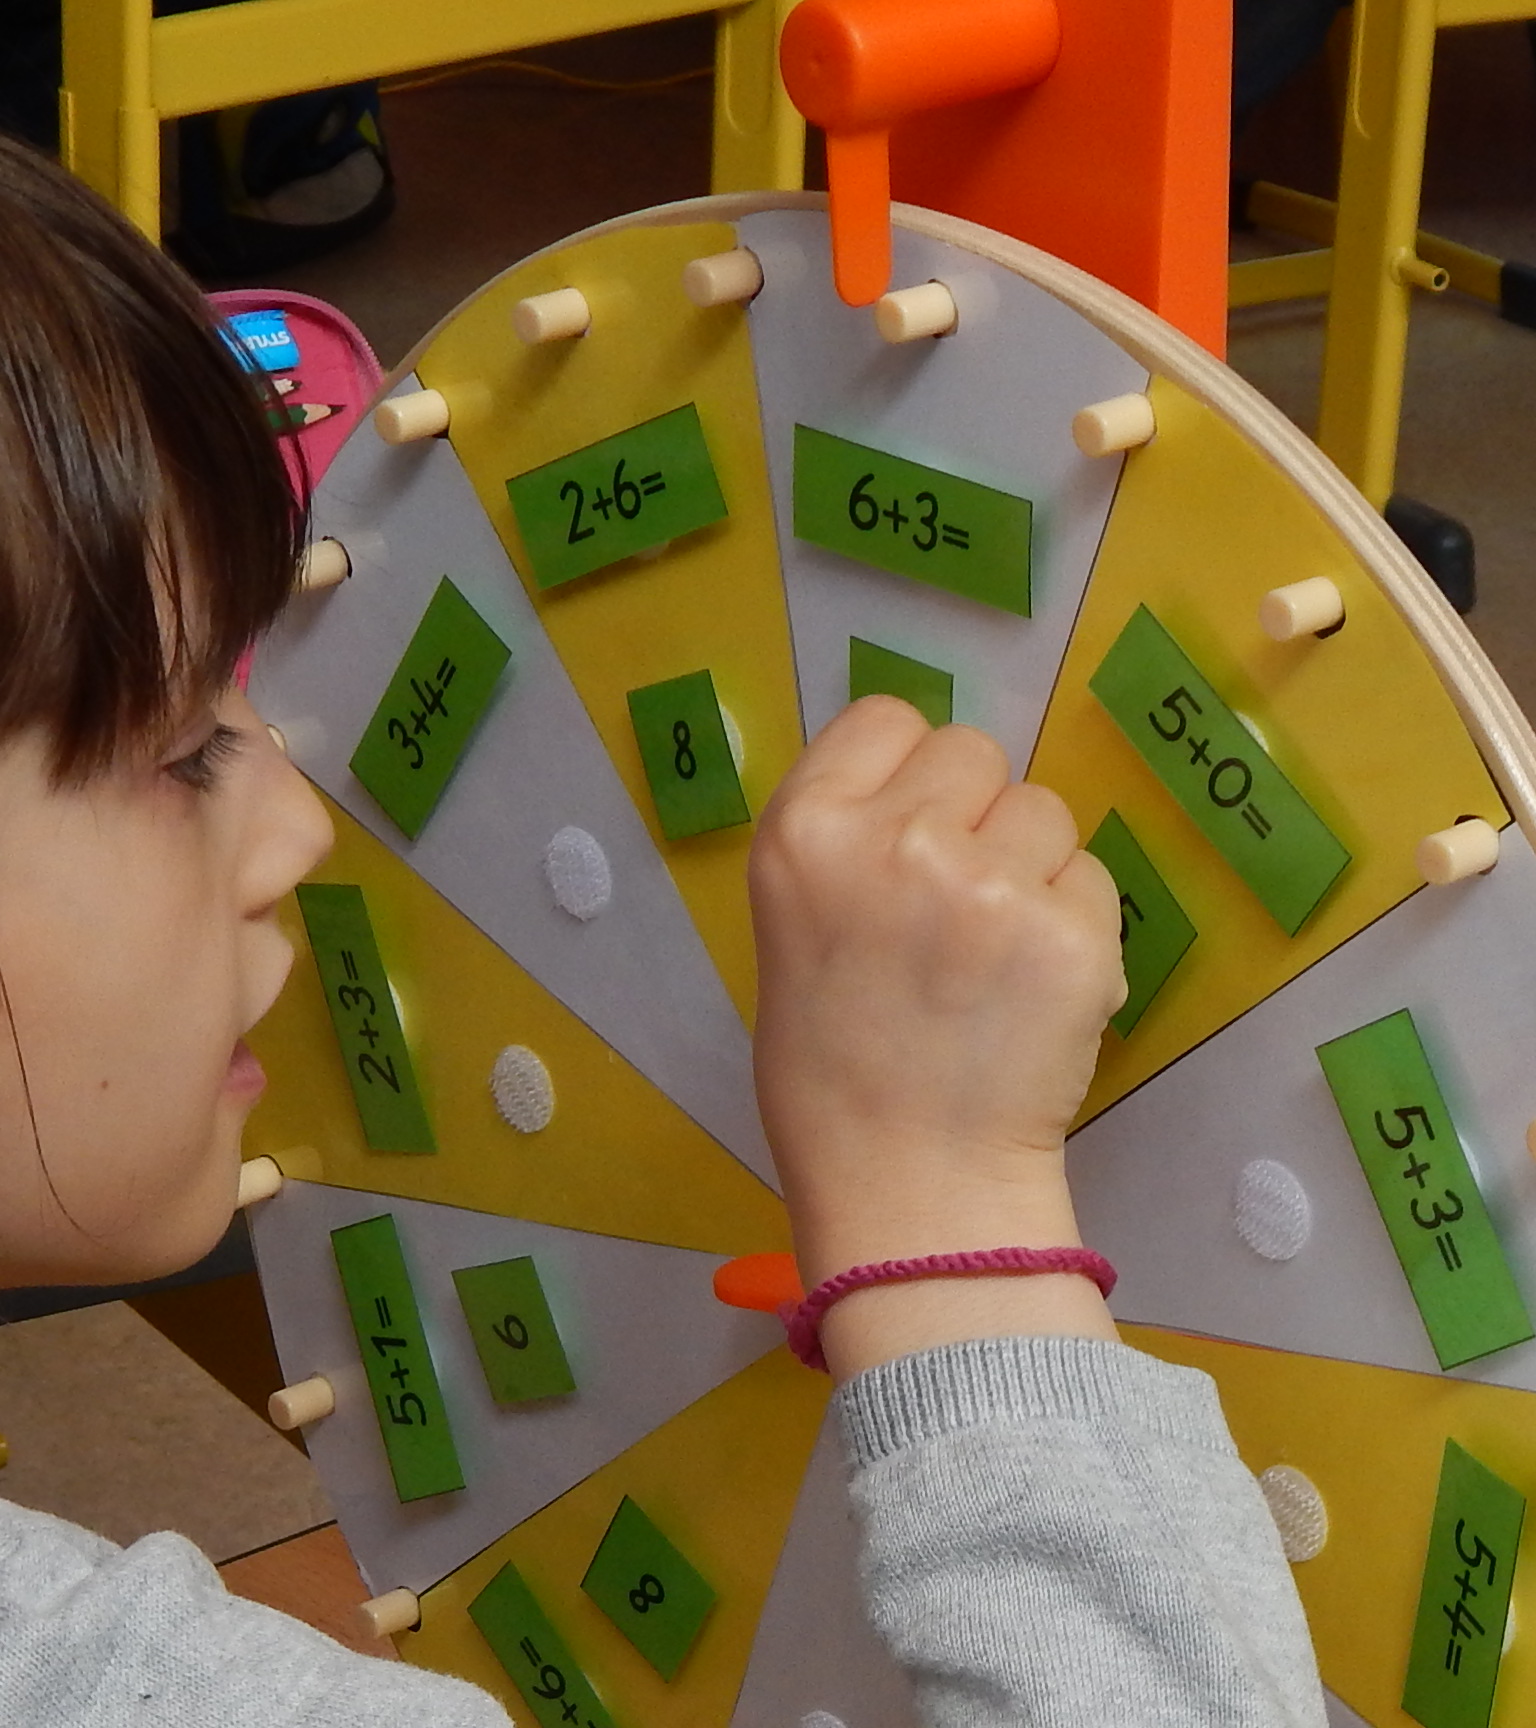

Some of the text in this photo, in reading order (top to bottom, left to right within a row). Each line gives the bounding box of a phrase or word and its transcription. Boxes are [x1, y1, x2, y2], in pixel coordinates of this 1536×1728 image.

[560, 459, 665, 544] 2+6=
[849, 474, 969, 551] 6+3=
[388, 658, 456, 769] 3+4=
[672, 720, 697, 780] 8
[1148, 686, 1273, 841] 5+0=
[337, 950, 401, 1094] 2+3=
[1375, 1105, 1464, 1272] 5+3=
[371, 1296, 427, 1427] 5+1=
[628, 1573, 665, 1614] 8
[1443, 1519, 1496, 1676] 5+4=
